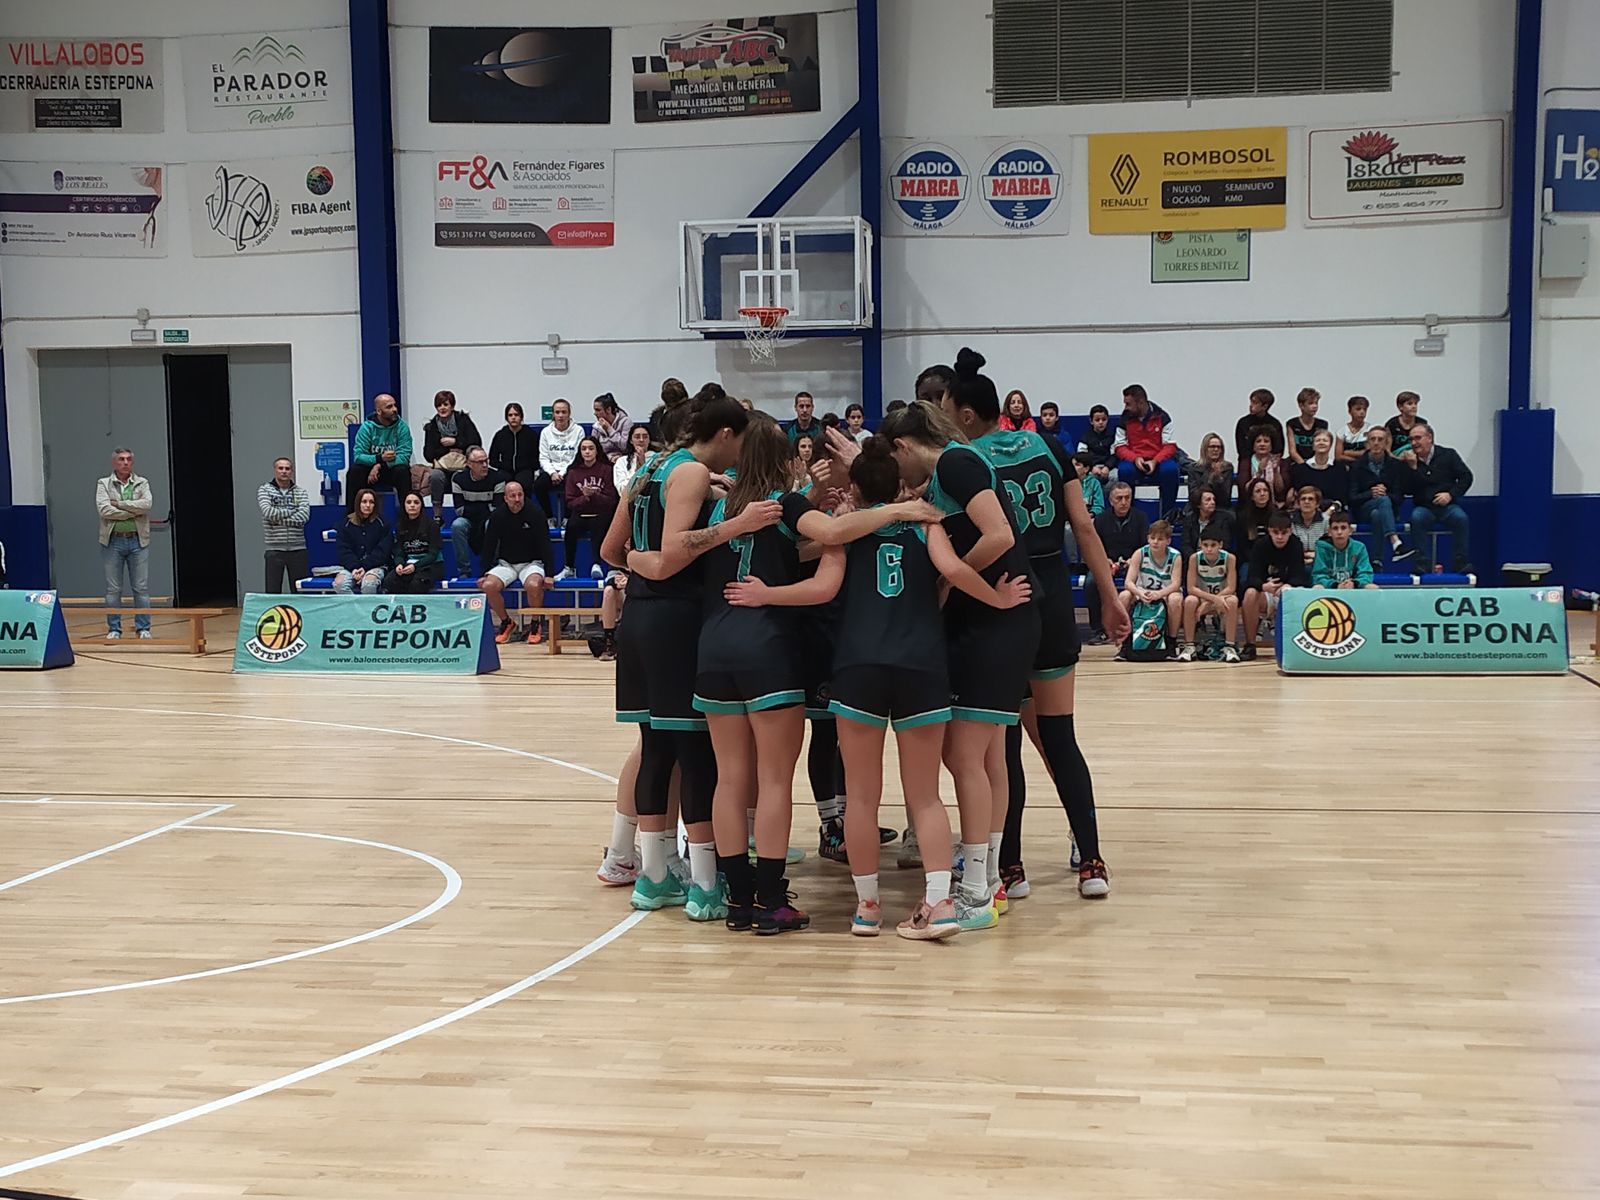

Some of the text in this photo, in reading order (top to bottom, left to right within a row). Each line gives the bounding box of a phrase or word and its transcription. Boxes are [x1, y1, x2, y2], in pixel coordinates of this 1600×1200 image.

[9, 43, 144, 65] VILLALOBOS
[724, 38, 778, 63] ABC
[212, 64, 225, 73] EL
[0, 76, 154, 90] CERRAJERIA ESTEPONA
[213, 71, 328, 93] PARADOR
[723, 81, 734, 92] EN
[737, 79, 776, 91] GENERAL
[214, 91, 327, 102] RESTAURANTE
[658, 96, 745, 109] WWW.TALLERESABC.COM
[248, 106, 295, 125] Pueblo
[1163, 148, 1275, 166] ROMBOSOL
[513, 160, 565, 171] Fernández
[907, 162, 953, 175] RADIO
[998, 161, 1045, 174] RADIO
[513, 171, 571, 181] & Asociados
[1349, 179, 1401, 190] JARDINES
[1415, 175, 1463, 186] PISCINAS
[900, 179, 960, 197] MARCA
[992, 177, 1052, 197] MARCA
[1172, 182, 1274, 193] NUEVO SEMINUEVO
[1101, 198, 1149, 207] RENAULT
[1172, 194, 1211, 204] OCASIÓN
[291, 200, 351, 215] FIBA Agent
[913, 222, 944, 230] MÁLAGA
[1004, 221, 1035, 229] MÁLAGA
[255, 228, 274, 245] SPORTS
[1189, 234, 1214, 243] PISTA
[1176, 248, 1227, 258] LEONARDO
[1163, 262, 1199, 272] TORRES
[729, 534, 754, 582] 7
[876, 543, 905, 598] 6
[1146, 577, 1163, 590] 23
[1434, 596, 1500, 617] CAB
[371, 604, 427, 624] CAB
[320, 629, 472, 649] ESTEPONA
[1380, 622, 1558, 644] ESTEPONA
[248, 642, 304, 662] ESTEPONA
[1296, 636, 1362, 657] ESTEPONA
[329, 655, 461, 666] www.baloncestoestepona.com
[1394, 651, 1548, 661] www.baloncestoestepona.com
